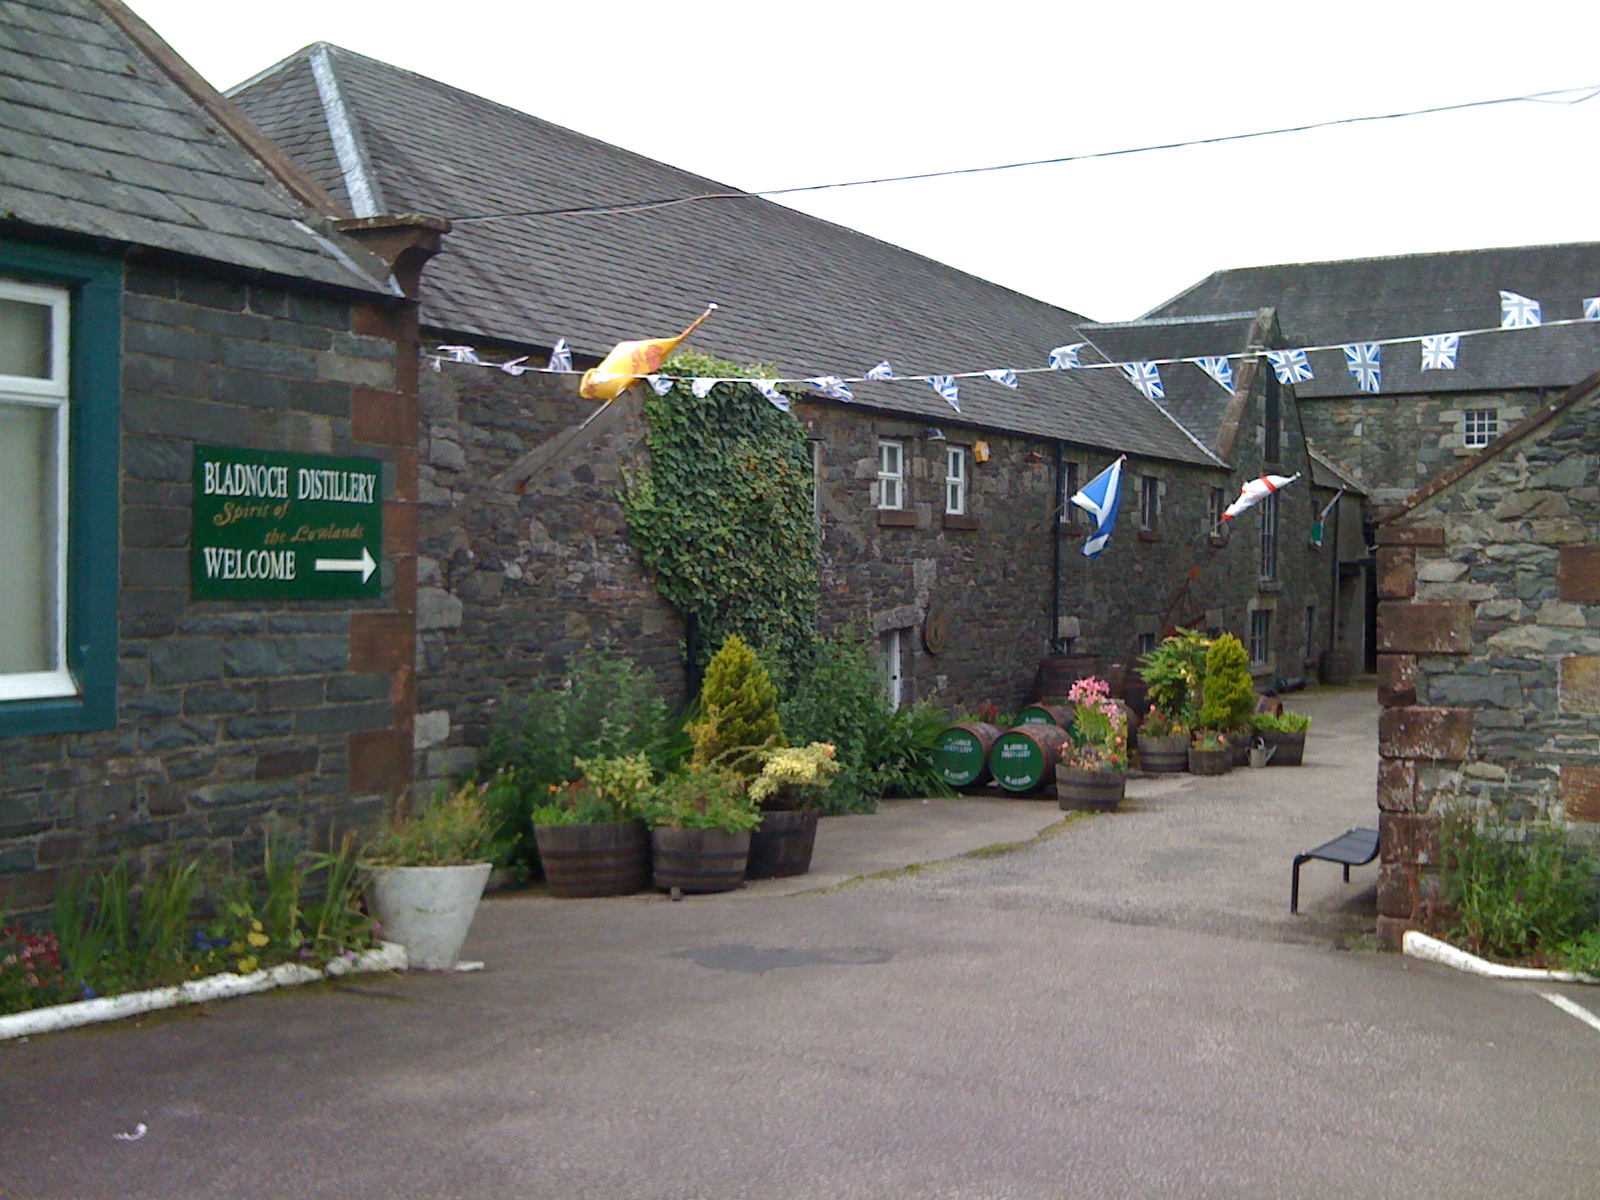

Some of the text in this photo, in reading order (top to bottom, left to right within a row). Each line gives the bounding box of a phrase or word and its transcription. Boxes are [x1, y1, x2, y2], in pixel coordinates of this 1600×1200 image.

[204, 461, 376, 504] BLADNOCH DISTILLERY
[213, 500, 290, 526] Spirit of
[264, 523, 365, 545] the Lowlands
[203, 547, 297, 580] WELCOME
